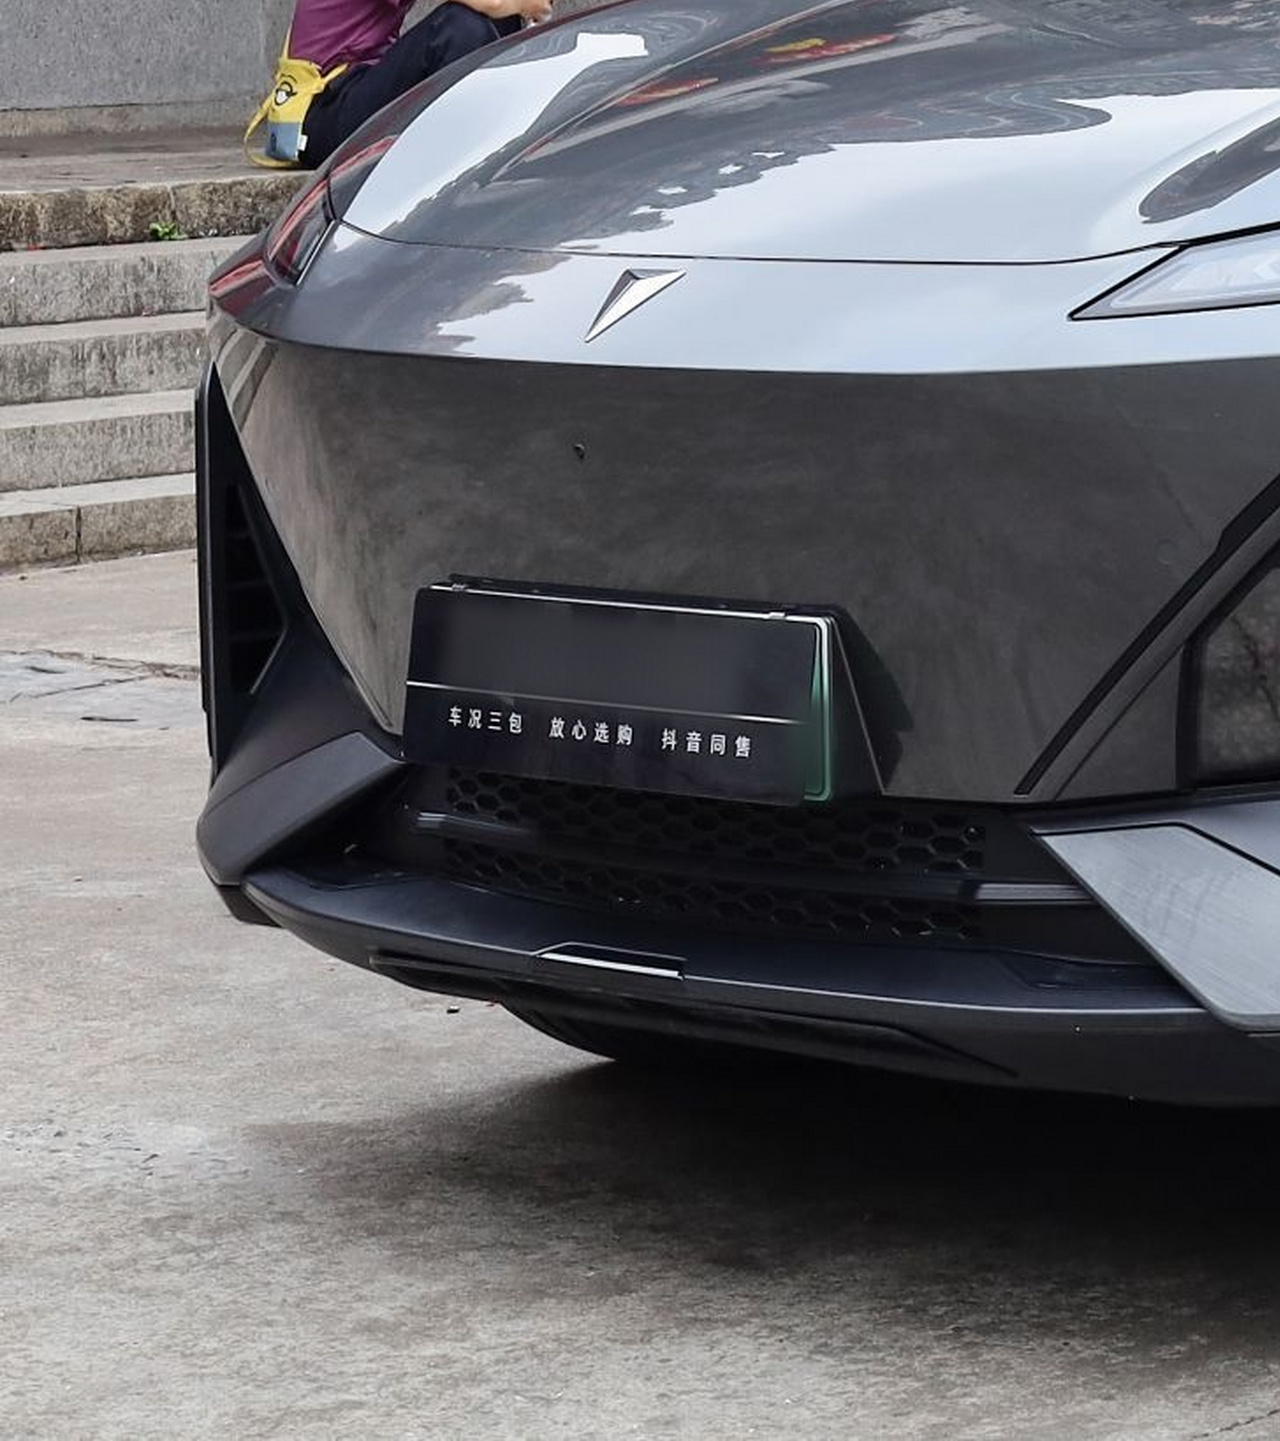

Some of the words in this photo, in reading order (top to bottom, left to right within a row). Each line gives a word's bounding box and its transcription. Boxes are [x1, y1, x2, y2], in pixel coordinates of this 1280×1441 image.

[448, 705, 522, 734] 车况三包
[549, 716, 633, 746] 放心选购
[661, 727, 751, 758] 抖音同售
